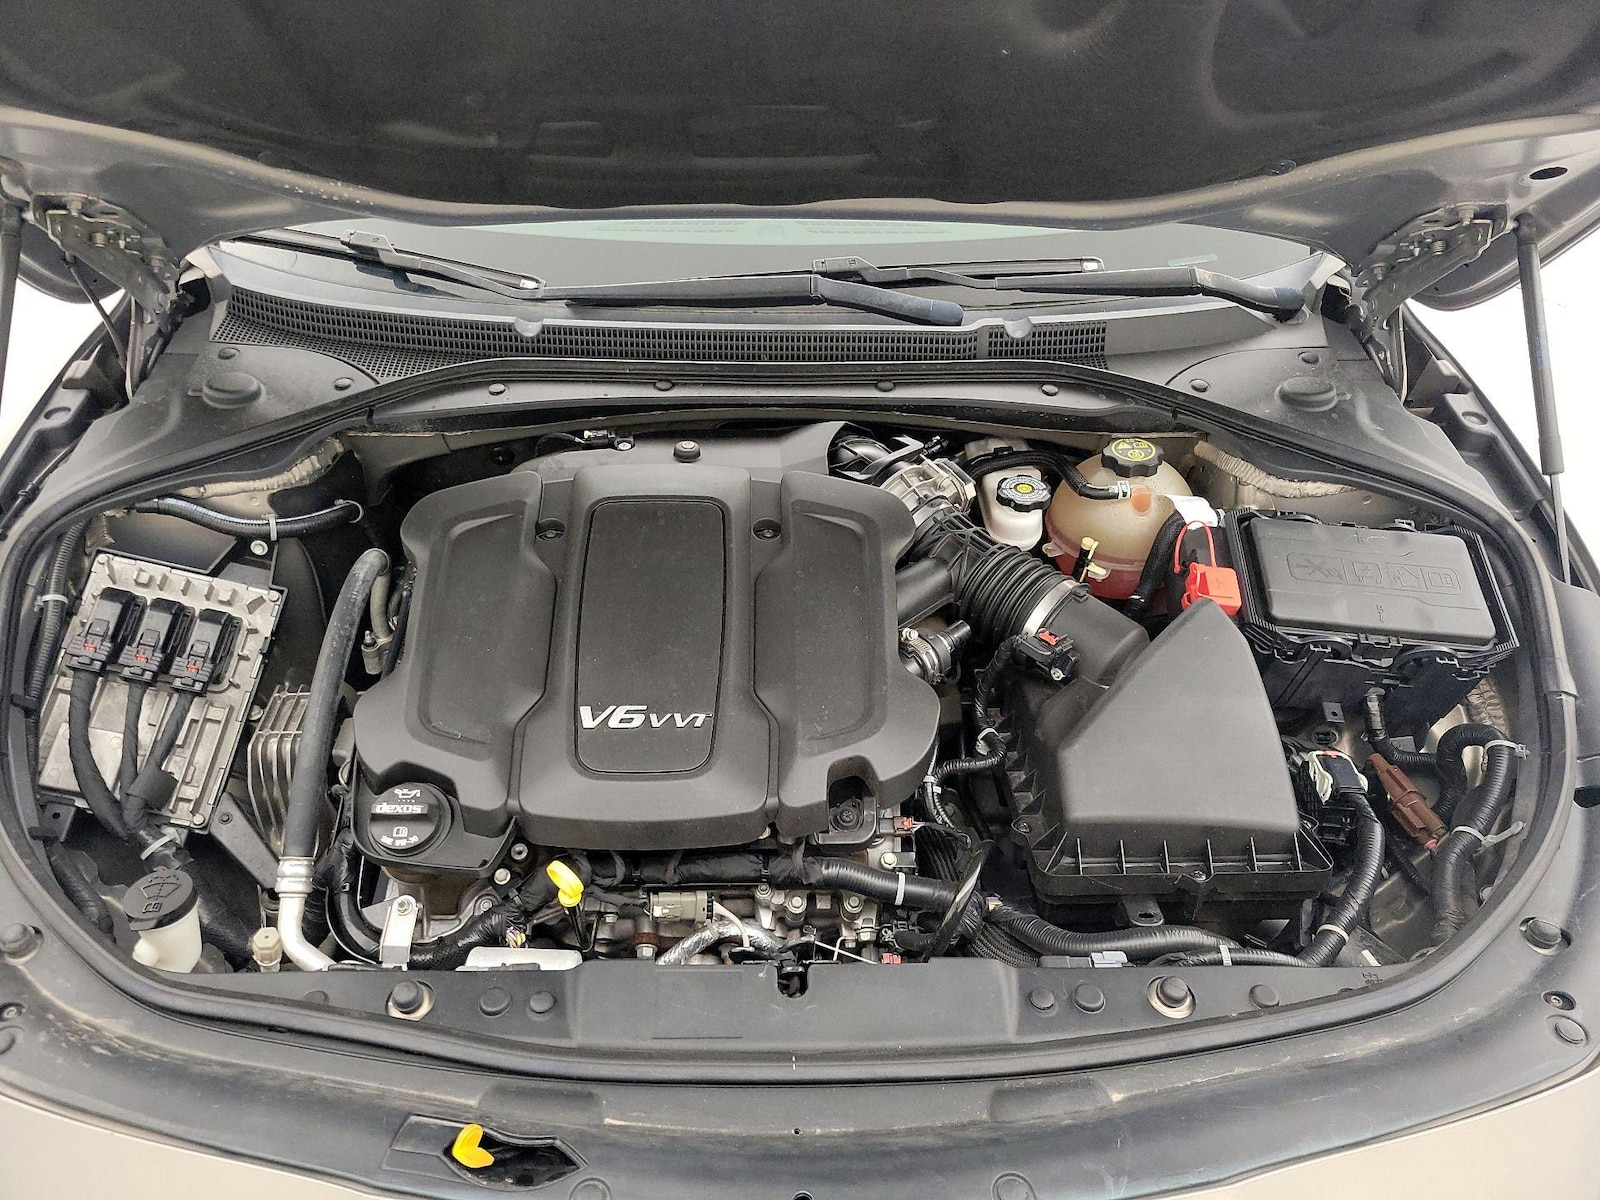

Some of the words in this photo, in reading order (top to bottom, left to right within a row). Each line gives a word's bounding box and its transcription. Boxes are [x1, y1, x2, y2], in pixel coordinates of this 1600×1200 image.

[579, 705, 648, 729] V6
[649, 712, 713, 729] VVT
[375, 802, 424, 814] dexos
